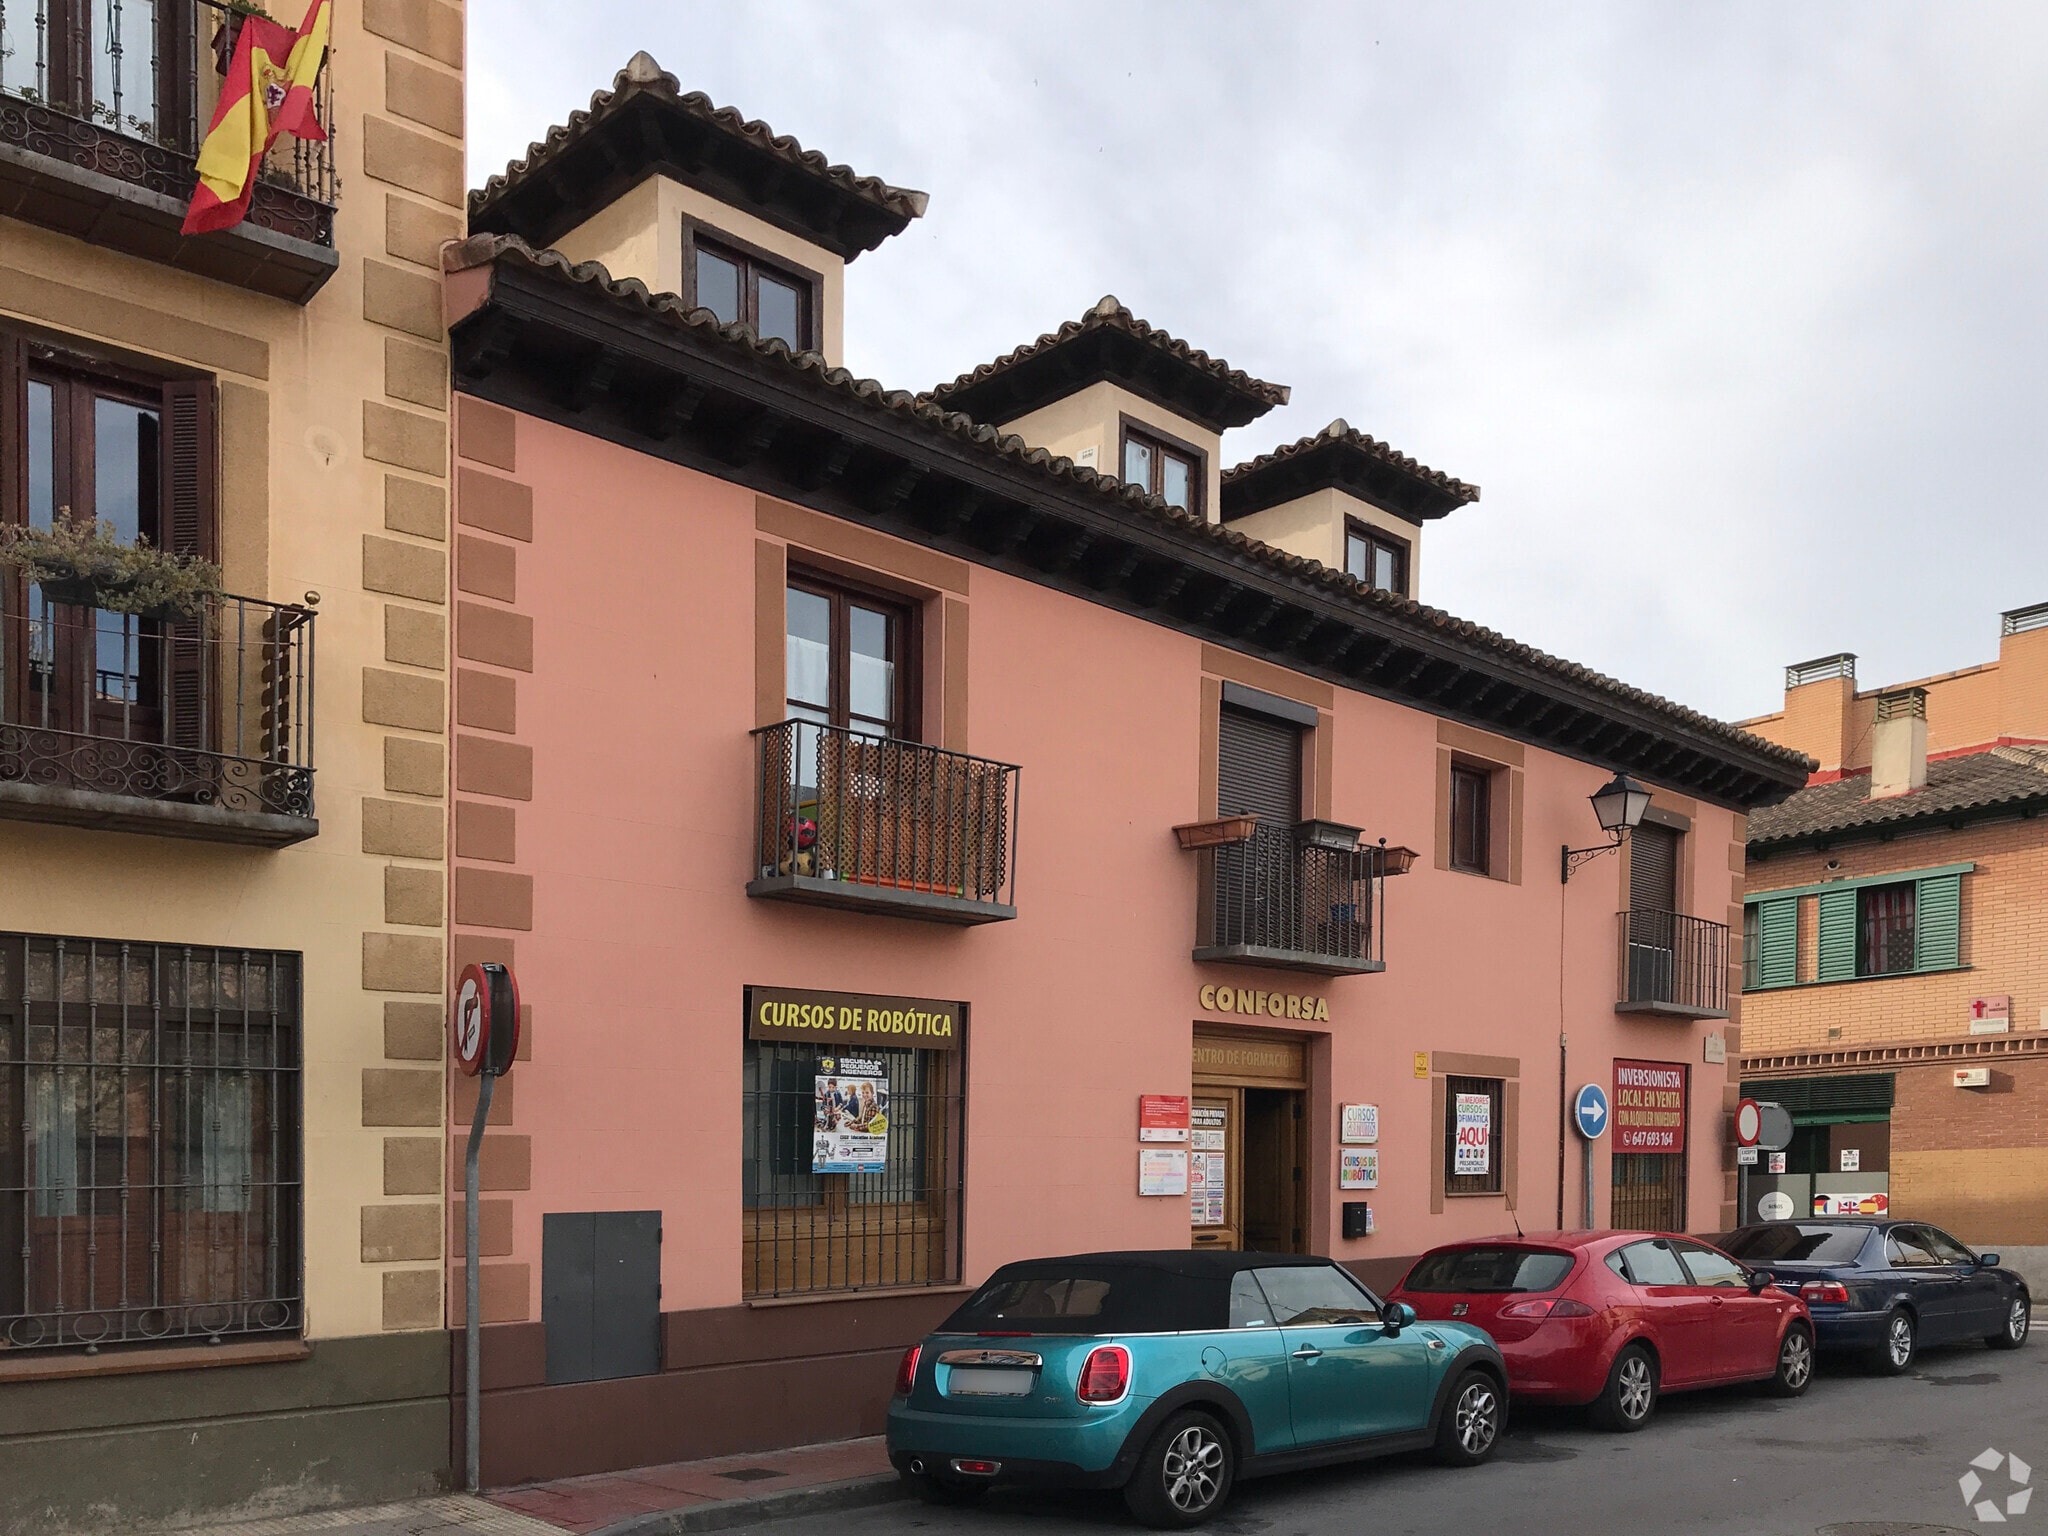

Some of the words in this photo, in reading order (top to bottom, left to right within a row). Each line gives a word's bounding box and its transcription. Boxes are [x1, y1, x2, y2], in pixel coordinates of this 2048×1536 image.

[1200, 984, 1330, 1022] CONFORSA
[759, 1001, 835, 1030] CURSOS
[839, 1007, 863, 1031] DE
[866, 1008, 952, 1037] ROBÓTICA
[840, 1057, 872, 1065] ESCUELA
[1192, 1048, 1225, 1065] ENTRO
[1227, 1050, 1240, 1065] DE
[840, 1068, 883, 1076] INGENIEROS
[1618, 1067, 1681, 1088] INVERSIONISTA
[1464, 1096, 1488, 1105] MEJORES
[1618, 1088, 1643, 1107] LOCAL
[1644, 1090, 1655, 1107] EN
[1656, 1091, 1681, 1109] VENTA
[1347, 1108, 1375, 1122] CURSOS
[1458, 1105, 1482, 1114] CURSOS
[1203, 1118, 1222, 1126] ADULTOS
[1618, 1110, 1629, 1126] CON
[1629, 1111, 1654, 1128] ALQUILER
[1654, 1111, 1680, 1127] INMEDIATO
[1458, 1124, 1488, 1147] AQUÍ
[1632, 1131, 1646, 1146] 647
[1646, 1132, 1660, 1146] 693
[1660, 1132, 1673, 1146] 164
[1343, 1156, 1368, 1167] CURSOS
[1368, 1156, 1376, 1167] DE
[1342, 1167, 1377, 1181] ROBÓTICA
